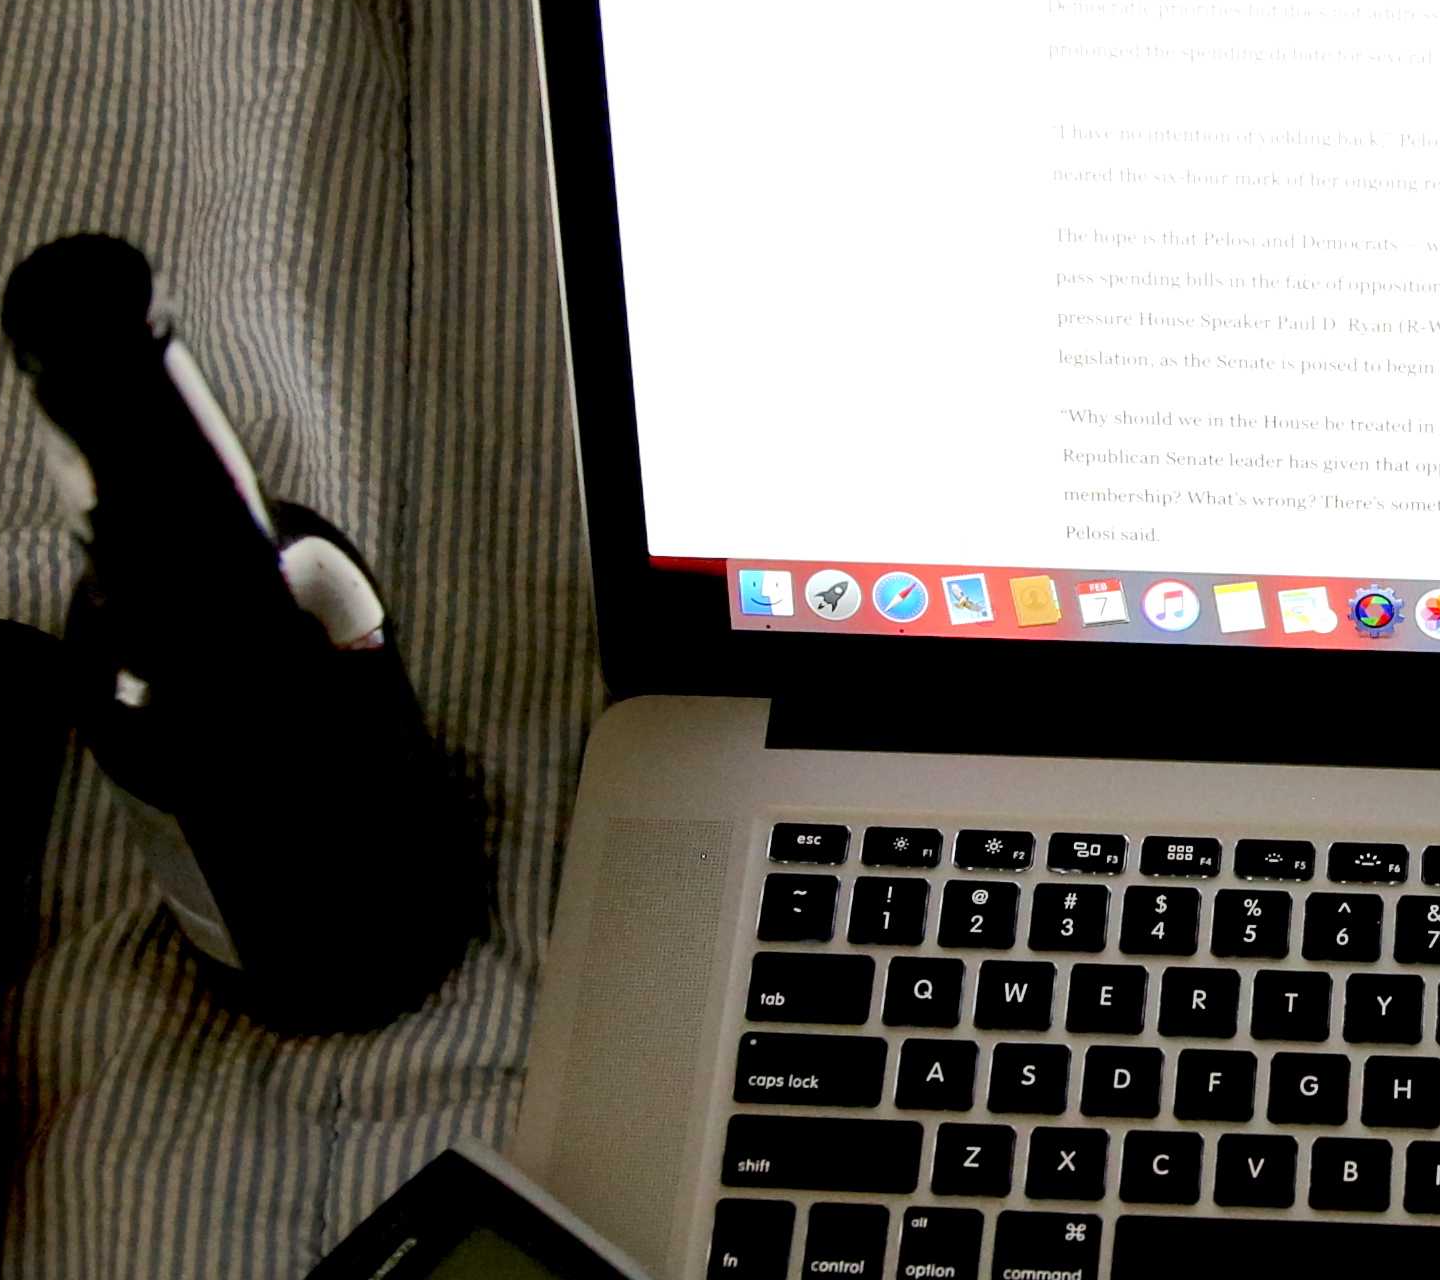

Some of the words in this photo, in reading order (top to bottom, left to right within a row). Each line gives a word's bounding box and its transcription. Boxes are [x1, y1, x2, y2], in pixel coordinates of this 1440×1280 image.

[1114, 408, 1172, 426] should
[1178, 415, 1202, 427] we
[1208, 412, 1223, 428] in
[1230, 411, 1256, 429] the
[1264, 412, 1319, 430] House
[1323, 413, 1344, 431] be
[1351, 414, 1411, 433] treated
[1419, 418, 1434, 434] in
[1064, 445, 1159, 469] Republican
[1166, 448, 1223, 467] Senate
[1230, 450, 1283, 469] leader
[1289, 452, 1318, 470] has
[1321, 455, 1368, 475] given
[1376, 455, 1408, 473] that
[1064, 484, 1181, 509] membership?
[1252, 490, 1316, 512] wrong?
[1067, 523, 1114, 542] Pelosi
[1121, 525, 1160, 543] said.
[1087, 582, 1108, 593] FEB
[796, 834, 822, 845] esc
[922, 848, 933, 857] F1
[1012, 850, 1026, 860] F2
[1106, 854, 1119, 864] F3
[1199, 857, 1212, 866] F4
[1294, 860, 1307, 870] F5
[1388, 863, 1401, 873] F6
[882, 911, 891, 930] 1
[969, 914, 984, 933] 2
[1060, 918, 1074, 937] 3
[1150, 921, 1165, 940] 4
[1243, 924, 1257, 943] 5
[1336, 927, 1349, 946] 6
[1427, 930, 1440, 949] 7
[760, 991, 785, 1006] tab
[913, 979, 933, 1000] Q
[1004, 982, 1029, 1003] W
[1099, 985, 1114, 1006] E
[1191, 989, 1207, 1010] R
[1284, 992, 1299, 1013] T
[1376, 995, 1393, 1016] Y
[748, 1075, 785, 1090] caps
[788, 1073, 819, 1089] lock
[925, 1061, 945, 1083] A
[1020, 1064, 1036, 1086] S
[1113, 1068, 1131, 1089] D
[1208, 1072, 1222, 1093] F
[1299, 1075, 1319, 1097] G
[1393, 1078, 1412, 1100] H
[737, 1158, 771, 1173] shift
[963, 1146, 982, 1168] Z
[1057, 1150, 1077, 1172] X
[1152, 1153, 1170, 1176] C
[1247, 1157, 1265, 1179] V
[1343, 1160, 1359, 1182] B
[722, 1252, 738, 1268] fn
[810, 1260, 865, 1274] control
[905, 1263, 956, 1280] option
